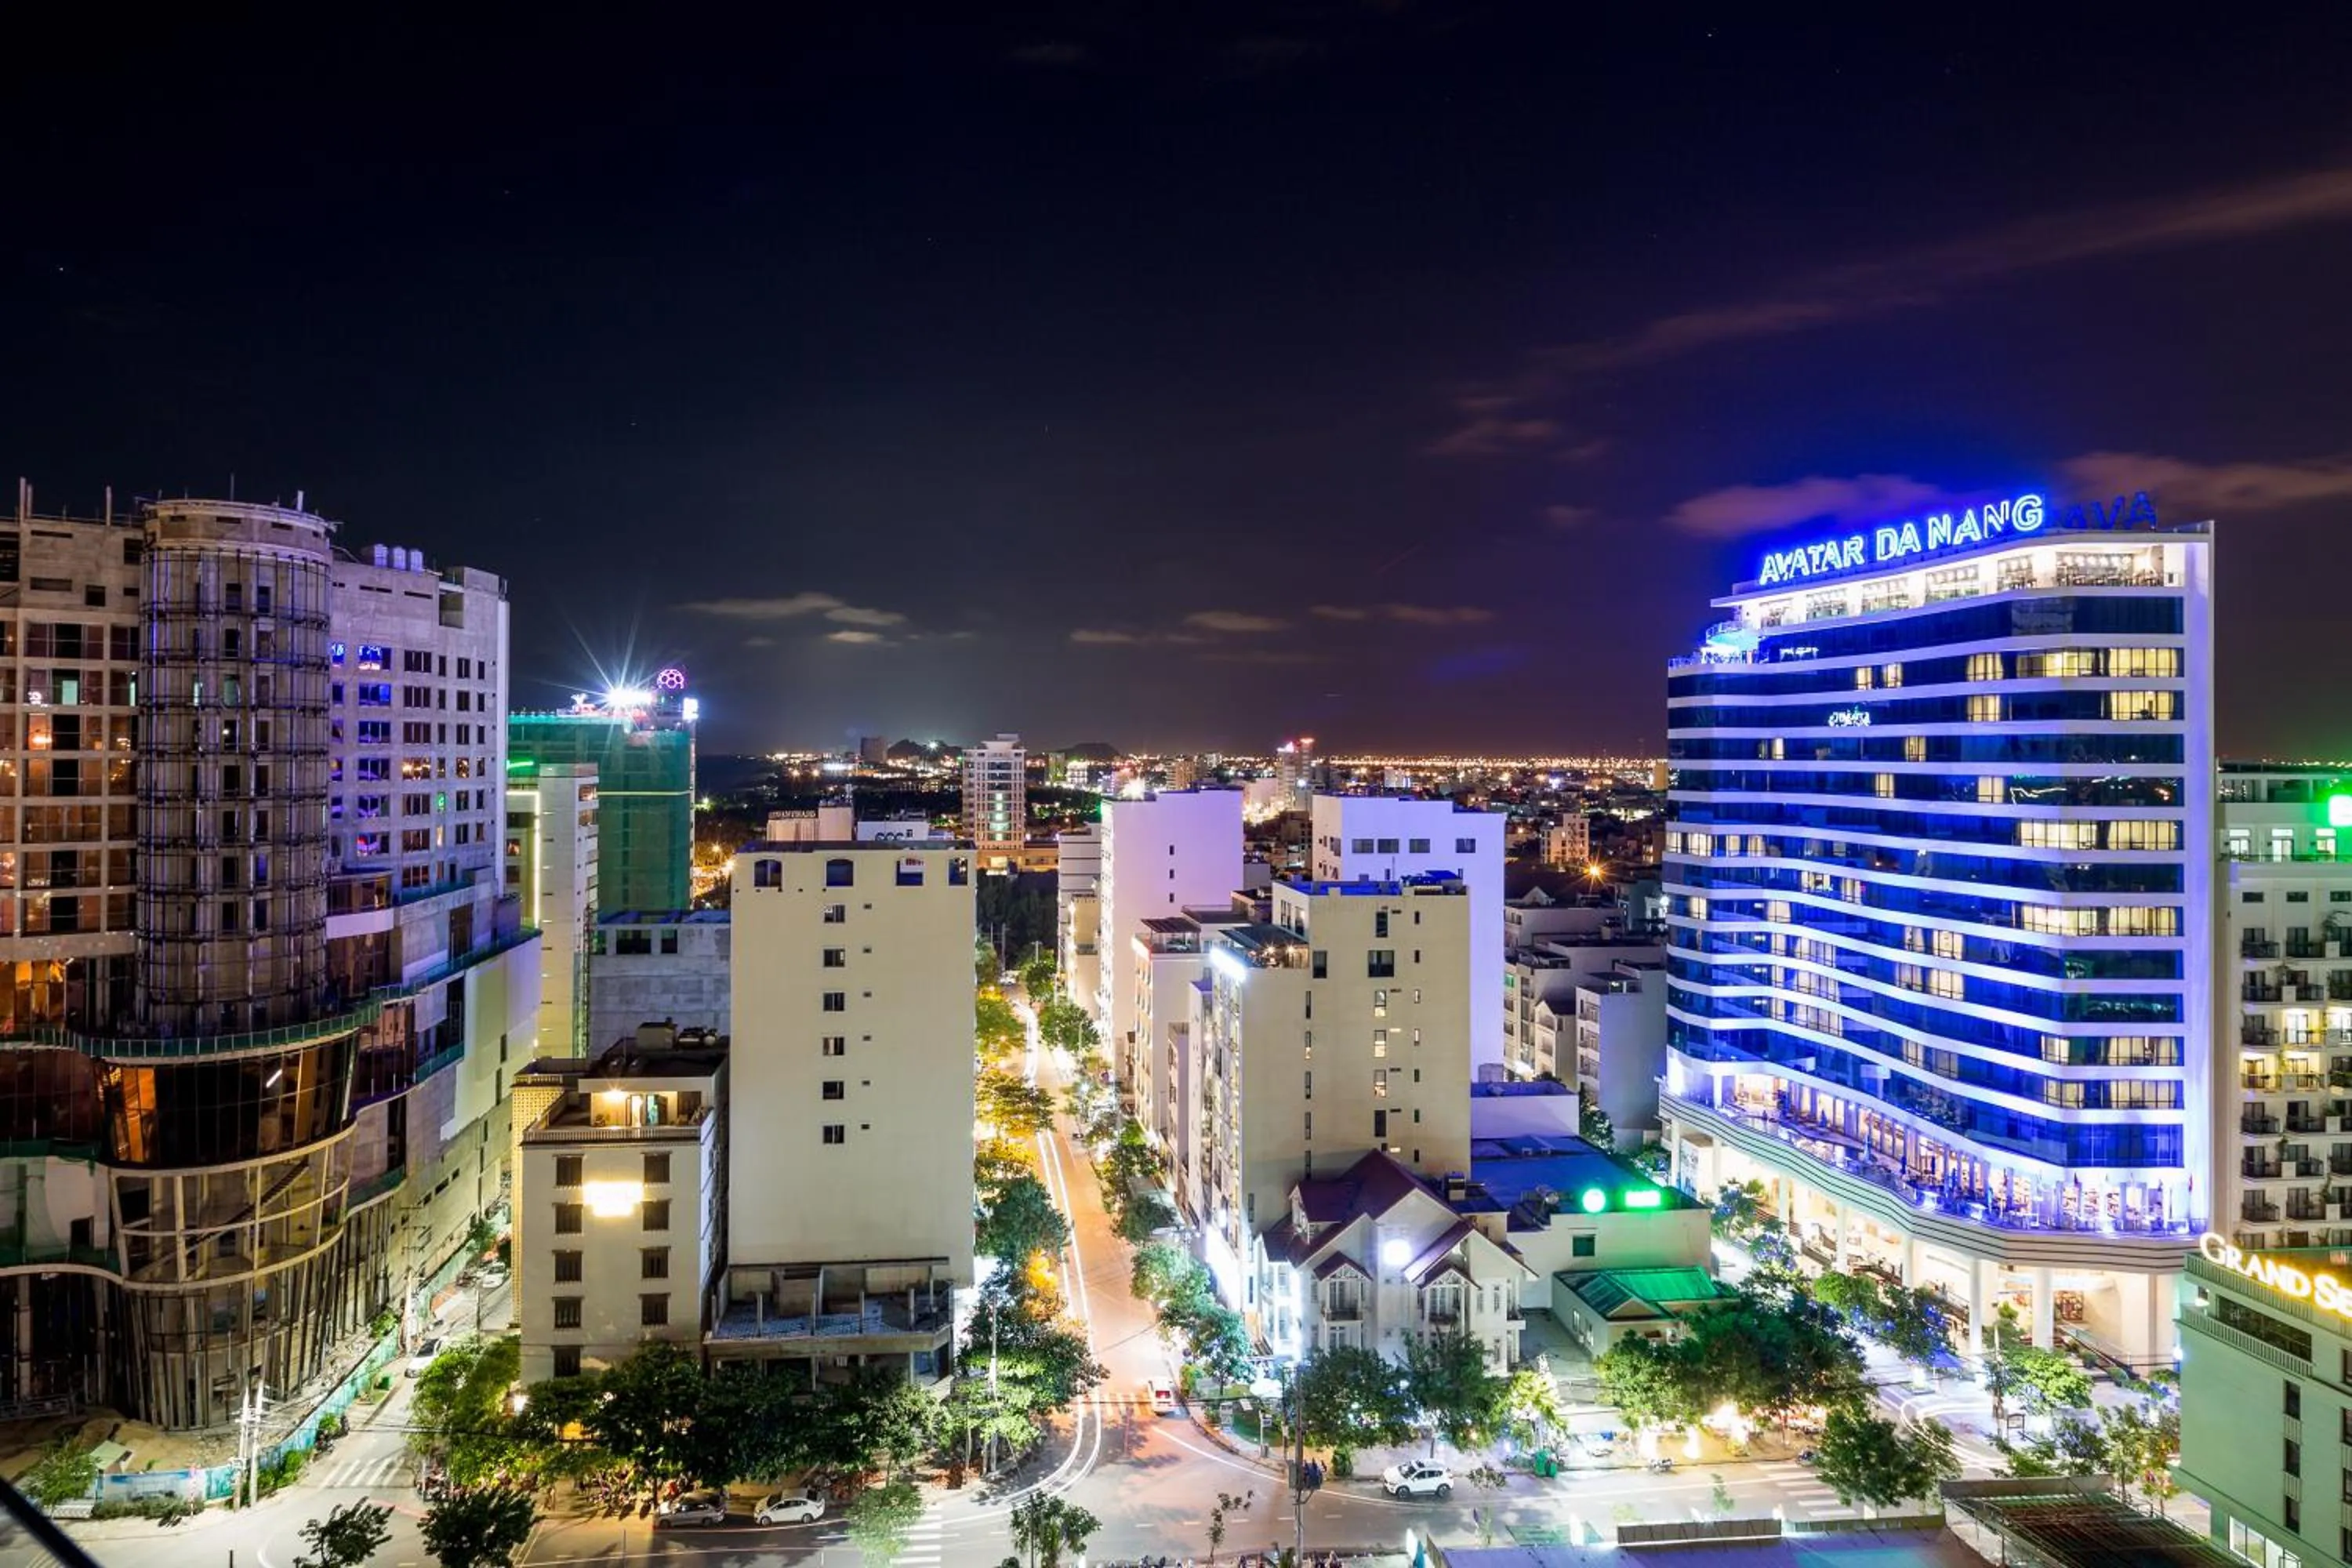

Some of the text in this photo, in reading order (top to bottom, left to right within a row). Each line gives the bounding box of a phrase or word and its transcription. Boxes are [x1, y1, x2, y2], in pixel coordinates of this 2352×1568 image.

[1759, 494, 2043, 585] AVATAR DA NANG
[2199, 1232, 2312, 1298] GRAND
